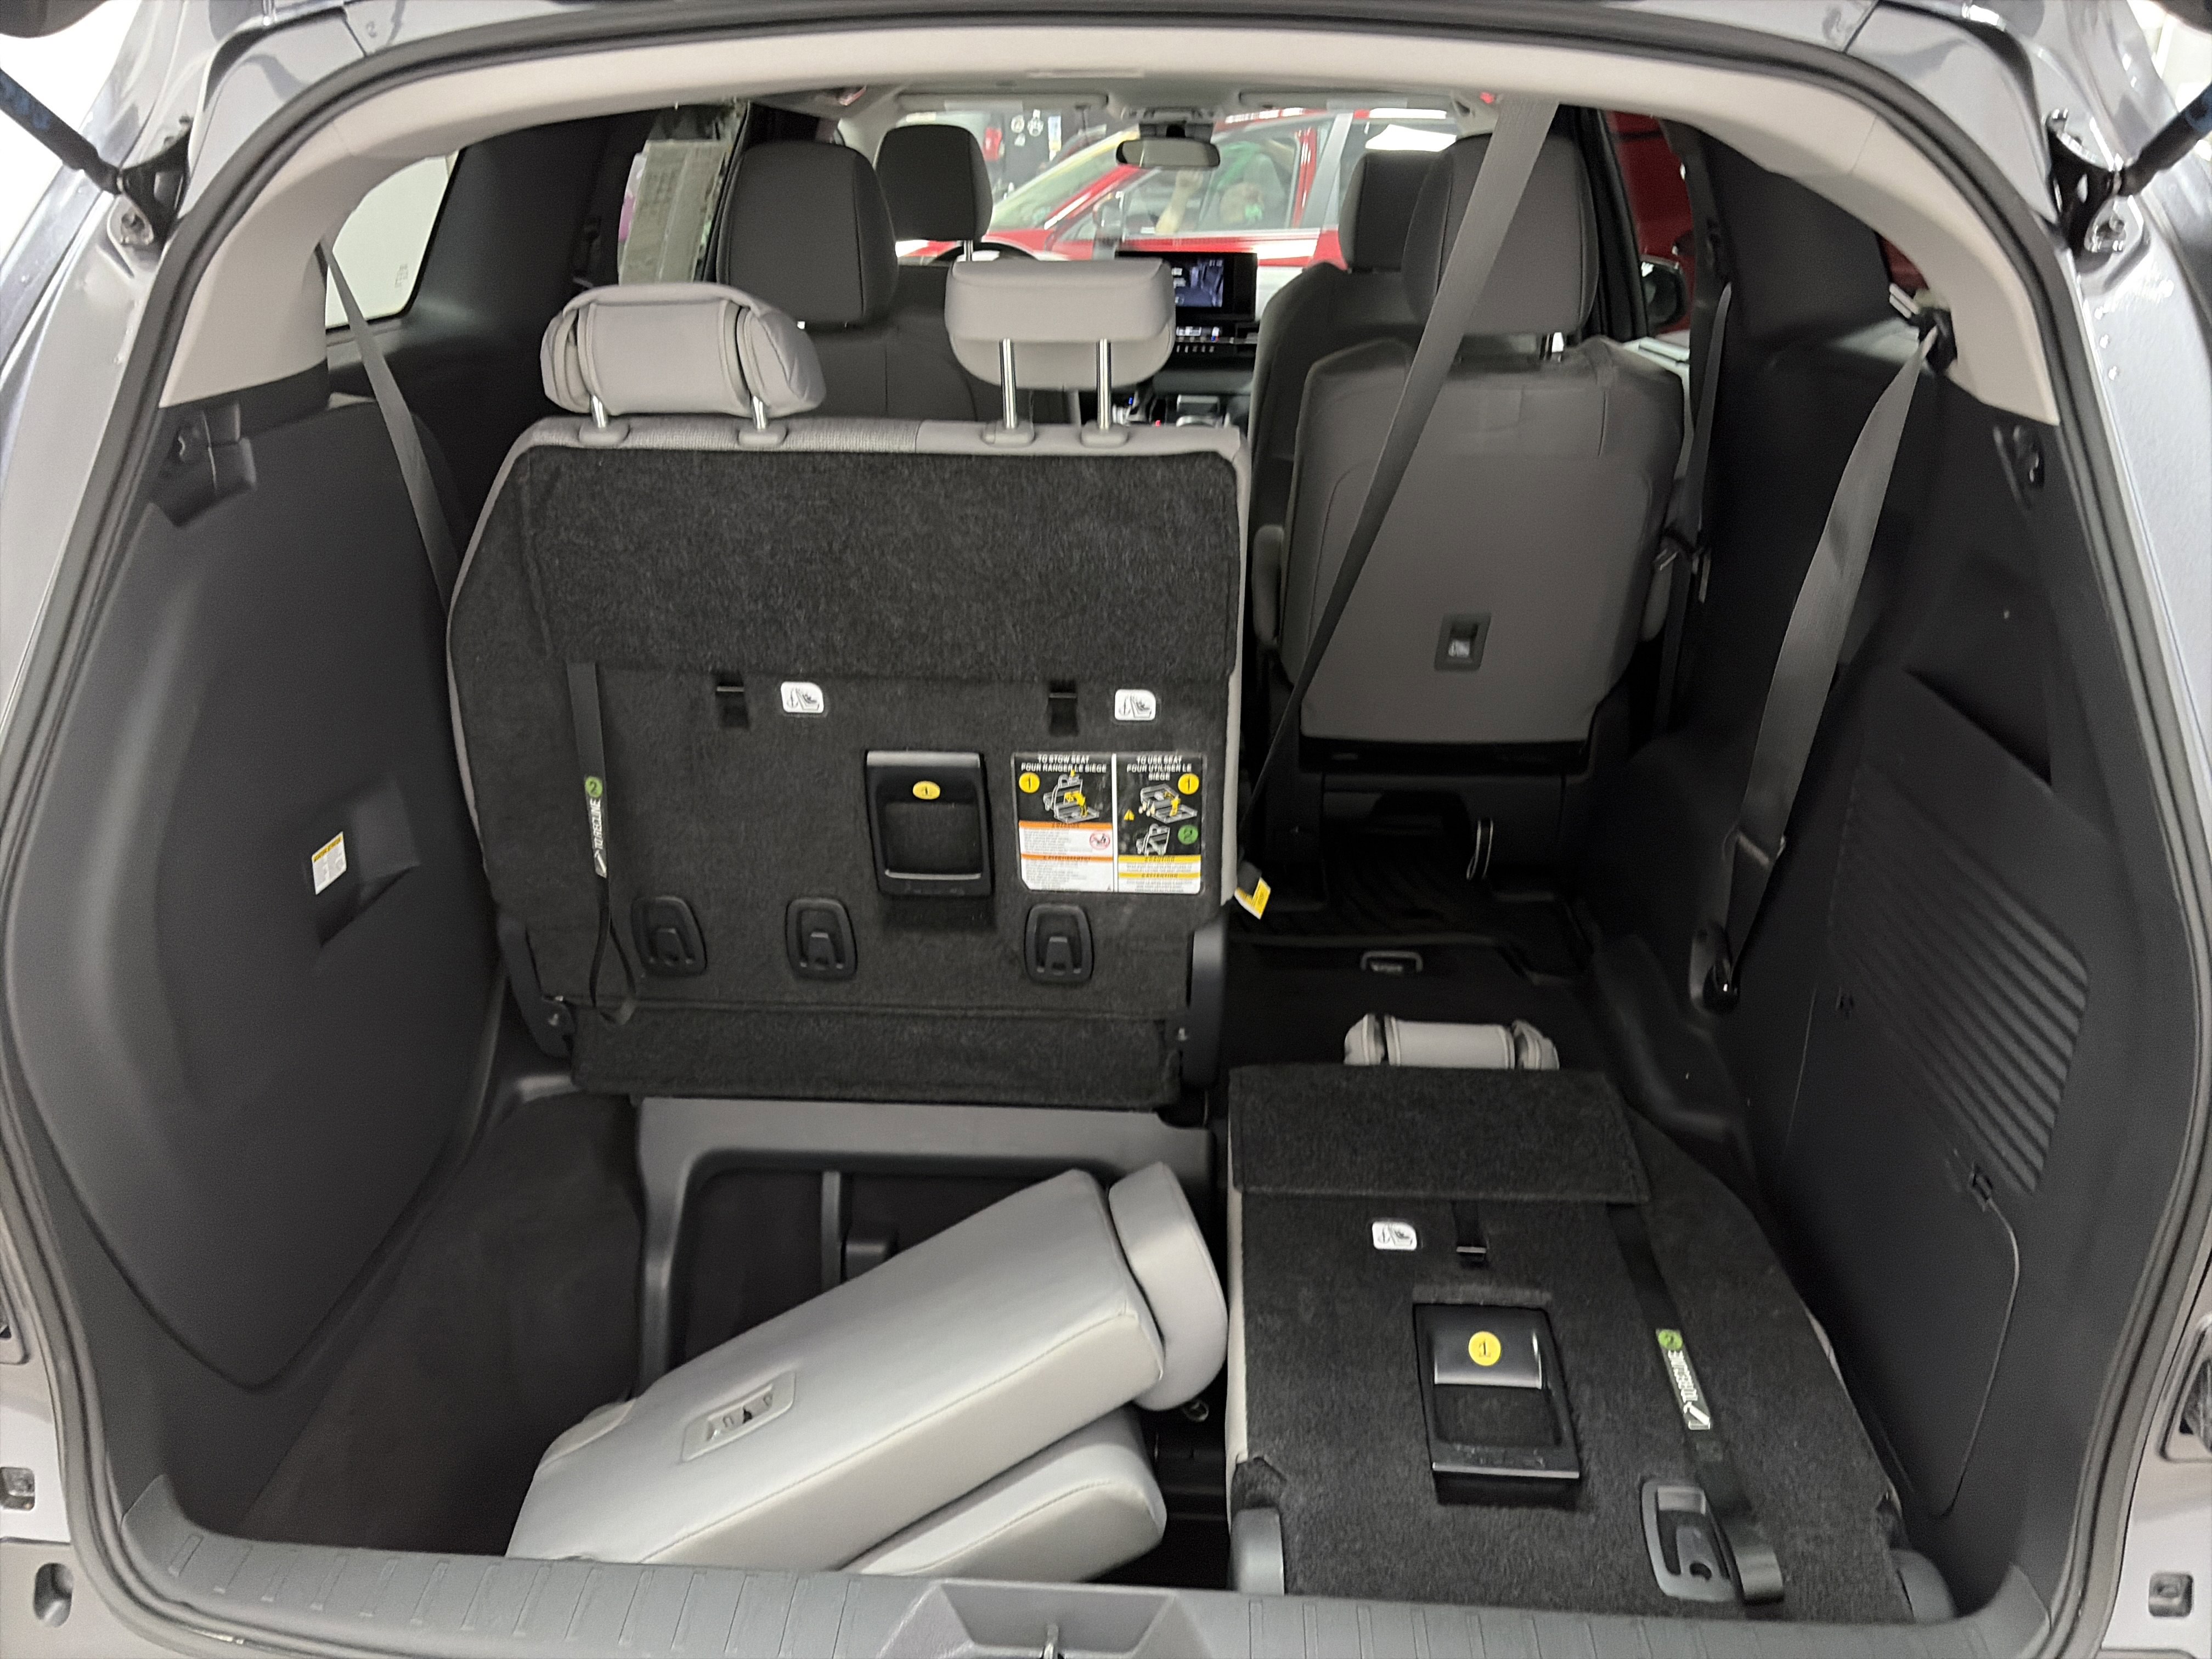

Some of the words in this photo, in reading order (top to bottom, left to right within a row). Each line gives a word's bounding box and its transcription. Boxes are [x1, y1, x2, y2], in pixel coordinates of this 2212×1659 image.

[1037, 754, 1048, 763] TO
[1049, 754, 1070, 764] STOW
[1071, 754, 1090, 764] SEAT
[1137, 755, 1147, 764] TO
[1148, 755, 1162, 764] USE
[1164, 755, 1182, 764] SEAT
[1021, 763, 1041, 771] POUR
[1043, 763, 1073, 772] RANGER
[1075, 764, 1083, 772] LE
[1126, 764, 1147, 772] POUR
[1182, 764, 1192, 772] LE
